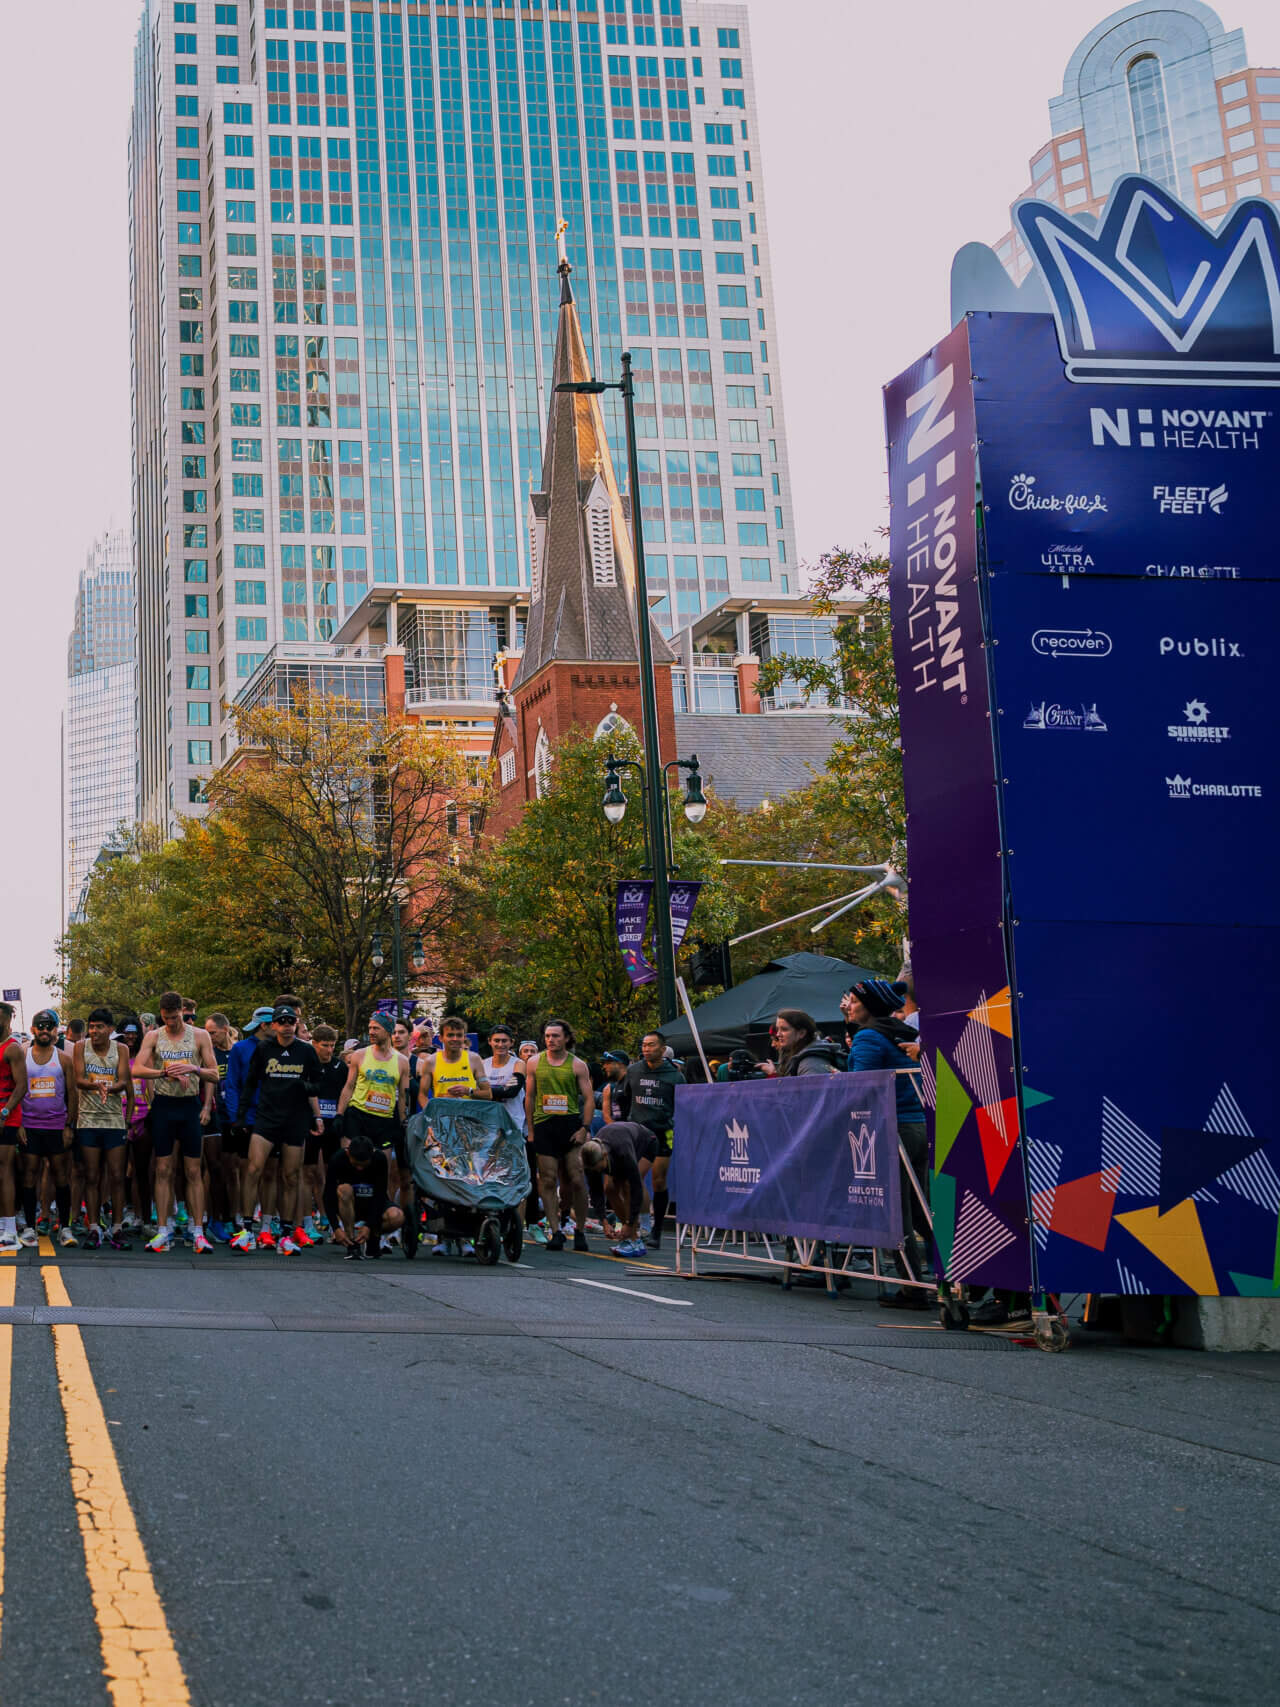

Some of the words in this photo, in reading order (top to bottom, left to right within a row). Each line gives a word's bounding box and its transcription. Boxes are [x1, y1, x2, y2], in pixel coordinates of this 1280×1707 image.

[1162, 409, 1267, 428] NOVANT
[1164, 430, 1259, 449] HEALTH
[1009, 481, 1108, 514] Chick-fil-A
[1153, 486, 1210, 500] FLEET
[1160, 500, 1206, 514] FEET
[1041, 554, 1095, 566] ULTRA
[934, 495, 967, 692] NOVANT
[907, 513, 937, 692] HEALTH
[1040, 638, 1105, 649] recover
[1160, 637, 1241, 657] Publix
[1168, 726, 1229, 739] SUNBELT
[1169, 784, 1191, 796] RUN
[1193, 784, 1262, 797] CHARLOTTE
[618, 917, 642, 925] MAKE
[625, 925, 634, 933] IT
[719, 1167, 761, 1183] CHARLOTTE
